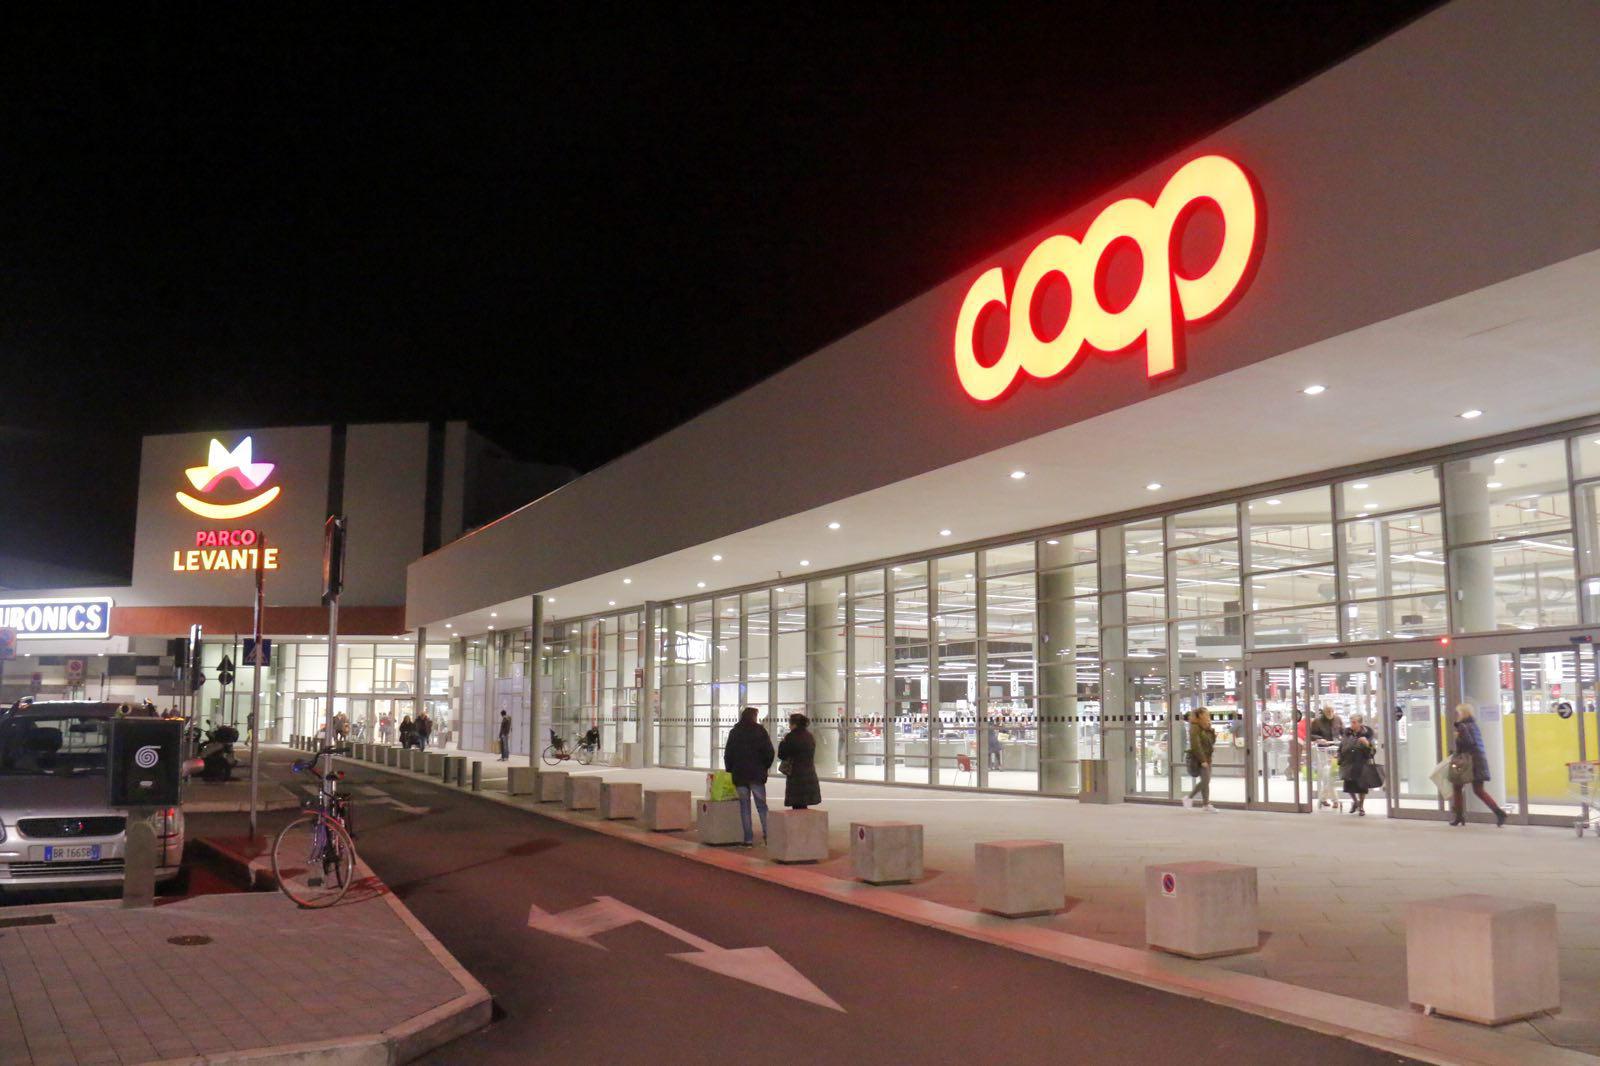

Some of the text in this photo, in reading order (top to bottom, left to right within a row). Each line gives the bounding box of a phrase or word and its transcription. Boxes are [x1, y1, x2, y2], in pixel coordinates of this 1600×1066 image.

[955, 155, 1256, 401] coop
[196, 529, 256, 546] PARCO
[173, 548, 278, 571] LEVANTE
